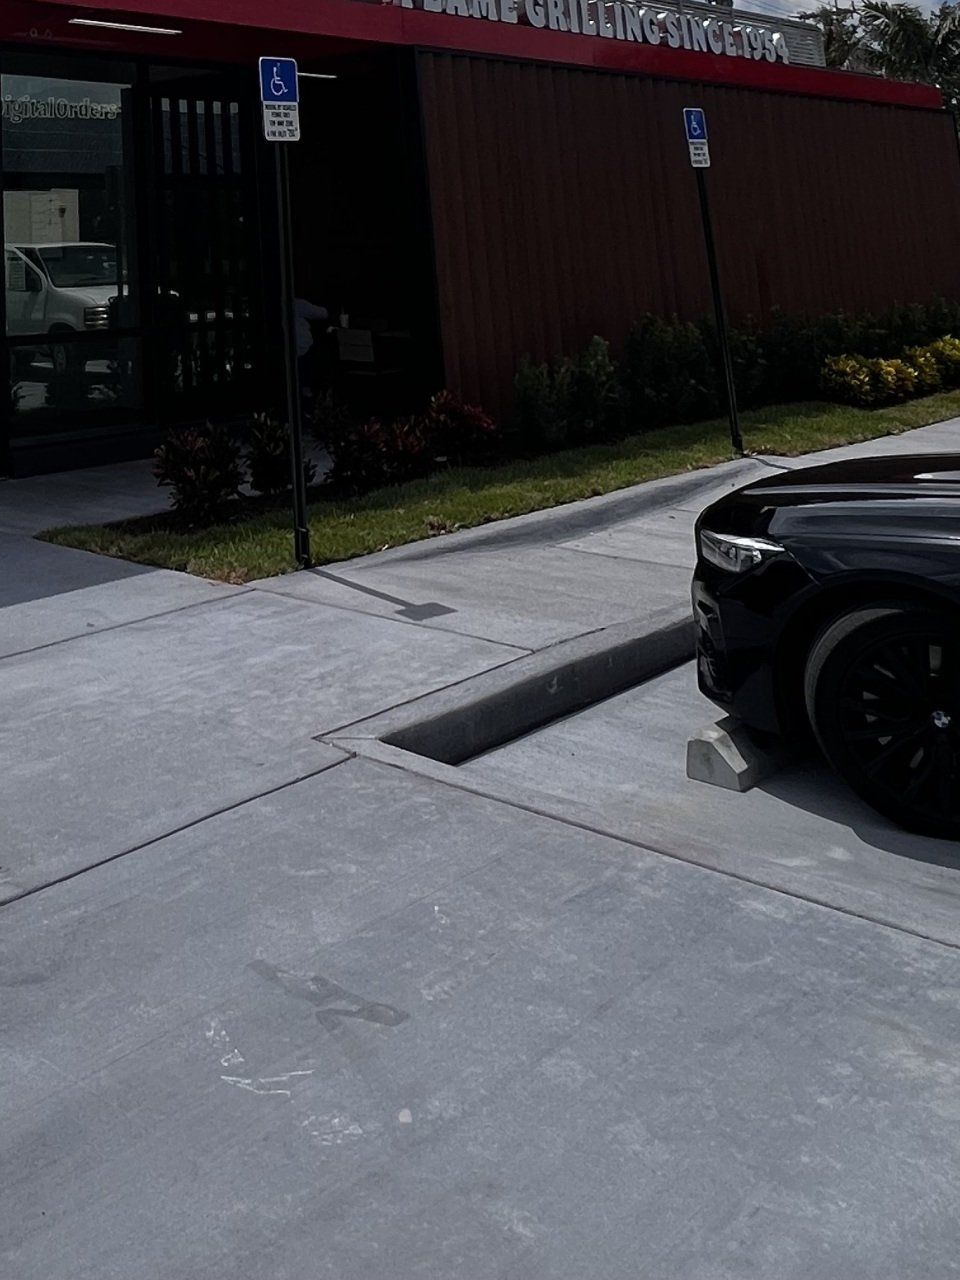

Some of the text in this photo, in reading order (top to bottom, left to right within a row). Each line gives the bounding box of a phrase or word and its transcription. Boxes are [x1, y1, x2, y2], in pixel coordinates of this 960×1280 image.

[663, 11, 738, 58] SINCE
[740, 24, 791, 65] 1954
[1, 94, 54, 123] igital
